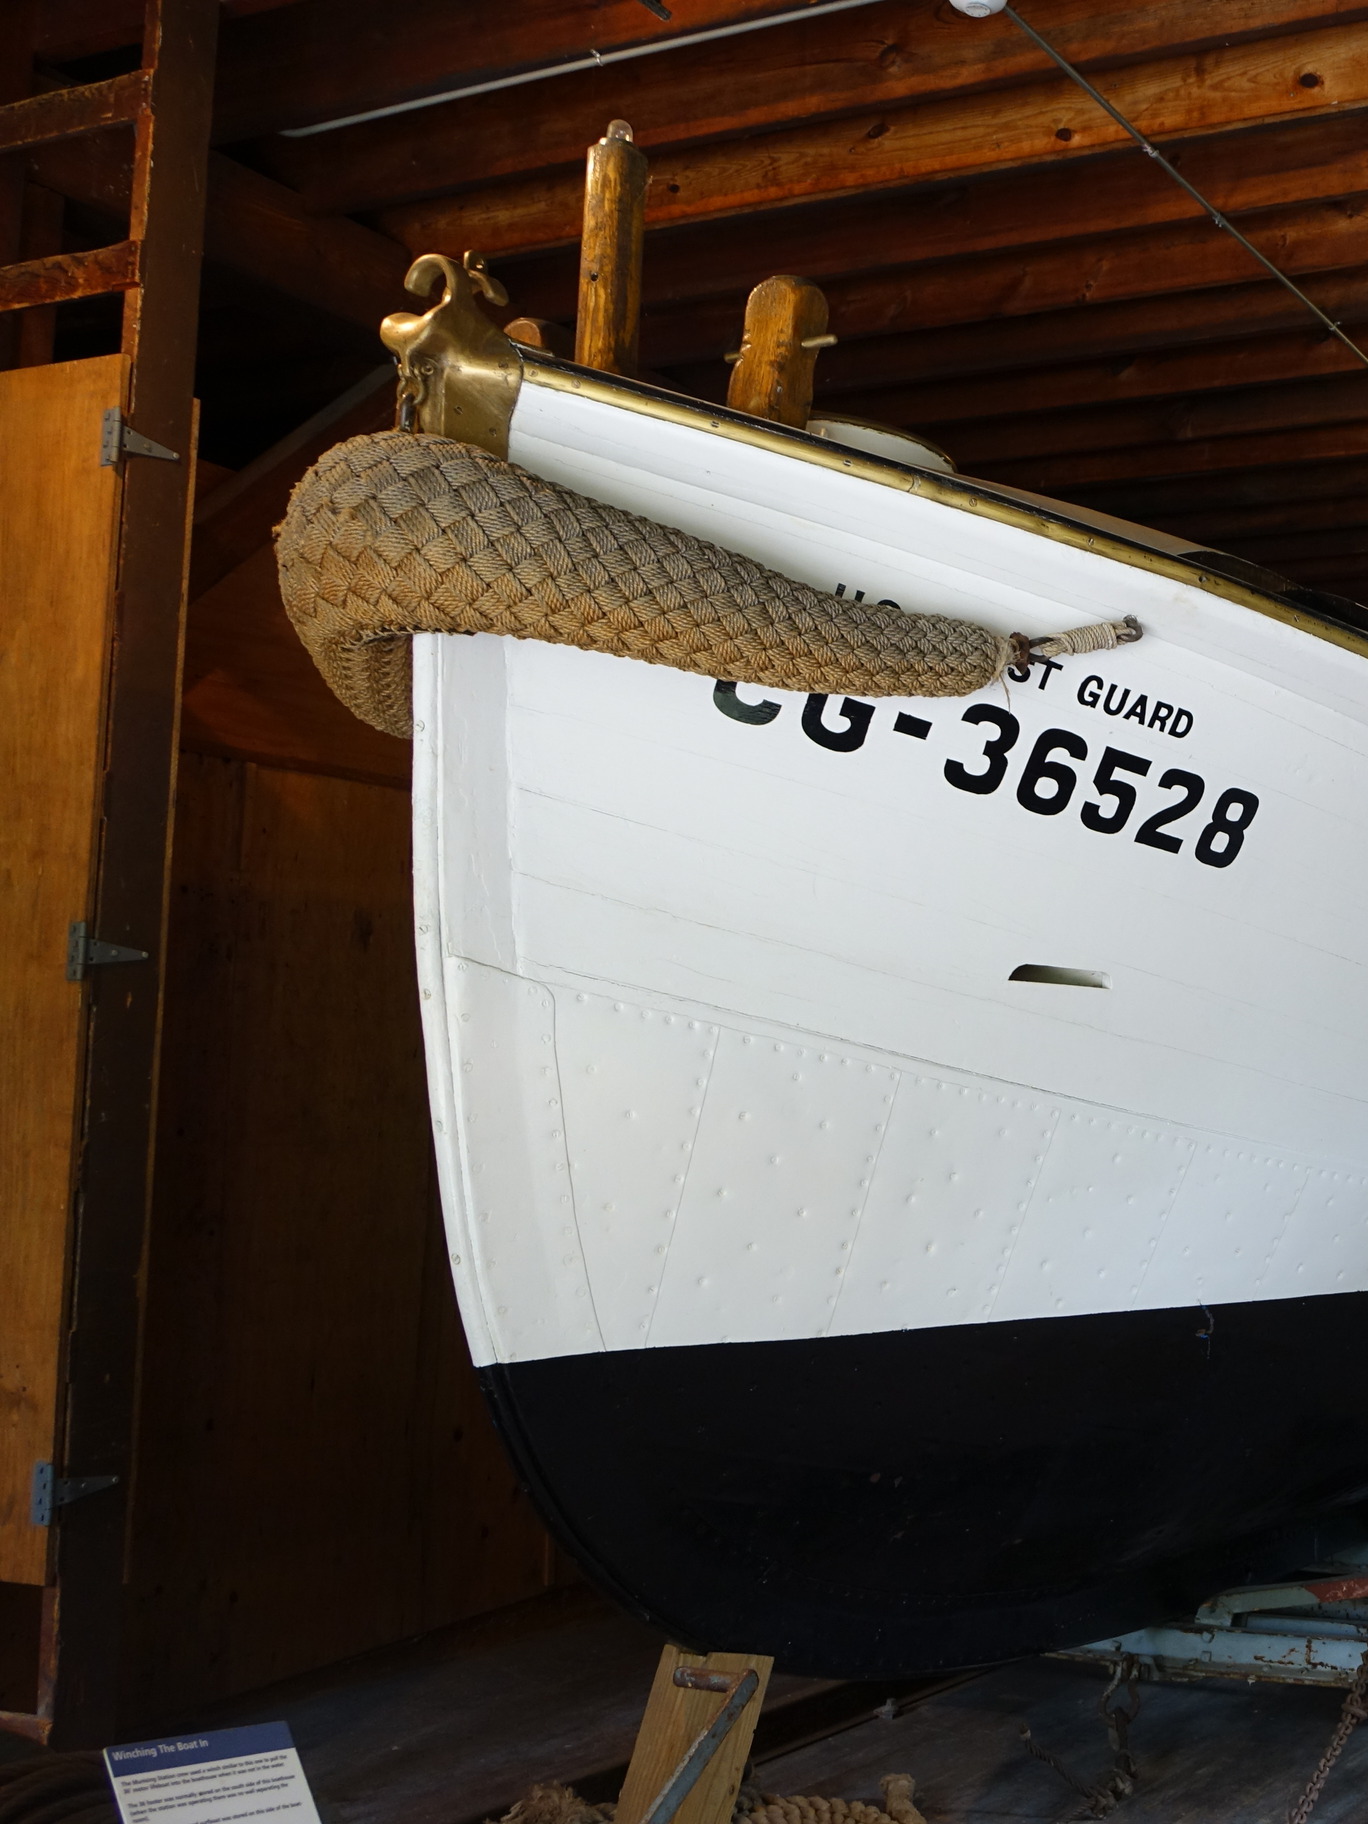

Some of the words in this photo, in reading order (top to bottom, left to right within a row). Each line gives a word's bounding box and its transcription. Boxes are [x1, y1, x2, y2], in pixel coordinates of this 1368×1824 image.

[1077, 675, 1194, 738] GUARD
[112, 1748, 158, 1761] Winching
[158, 1743, 175, 1754] The
[177, 1741, 198, 1752] Boat
